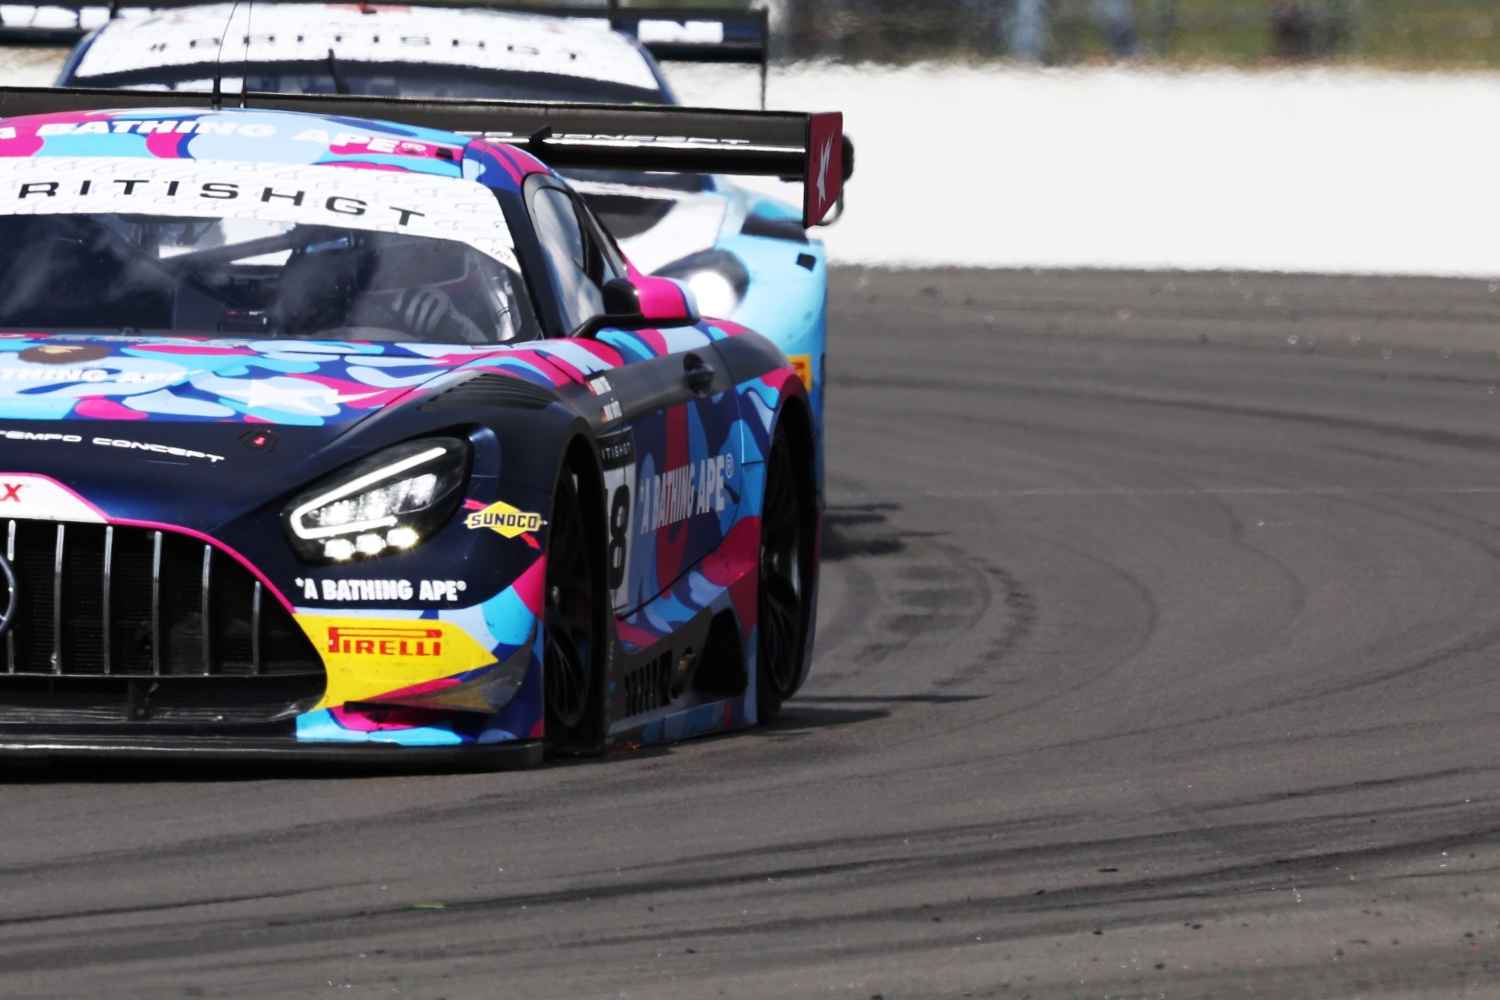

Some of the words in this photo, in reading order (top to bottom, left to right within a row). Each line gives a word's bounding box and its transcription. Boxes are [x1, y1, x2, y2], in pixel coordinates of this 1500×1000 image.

[35, 120, 277, 138] BATHING
[92, 438, 225, 463] CONCEPT
[652, 462, 695, 531] BATHING
[470, 514, 539, 530] SUNOCO
[321, 578, 414, 601] BATHING
[328, 626, 443, 656] PIRELLI
